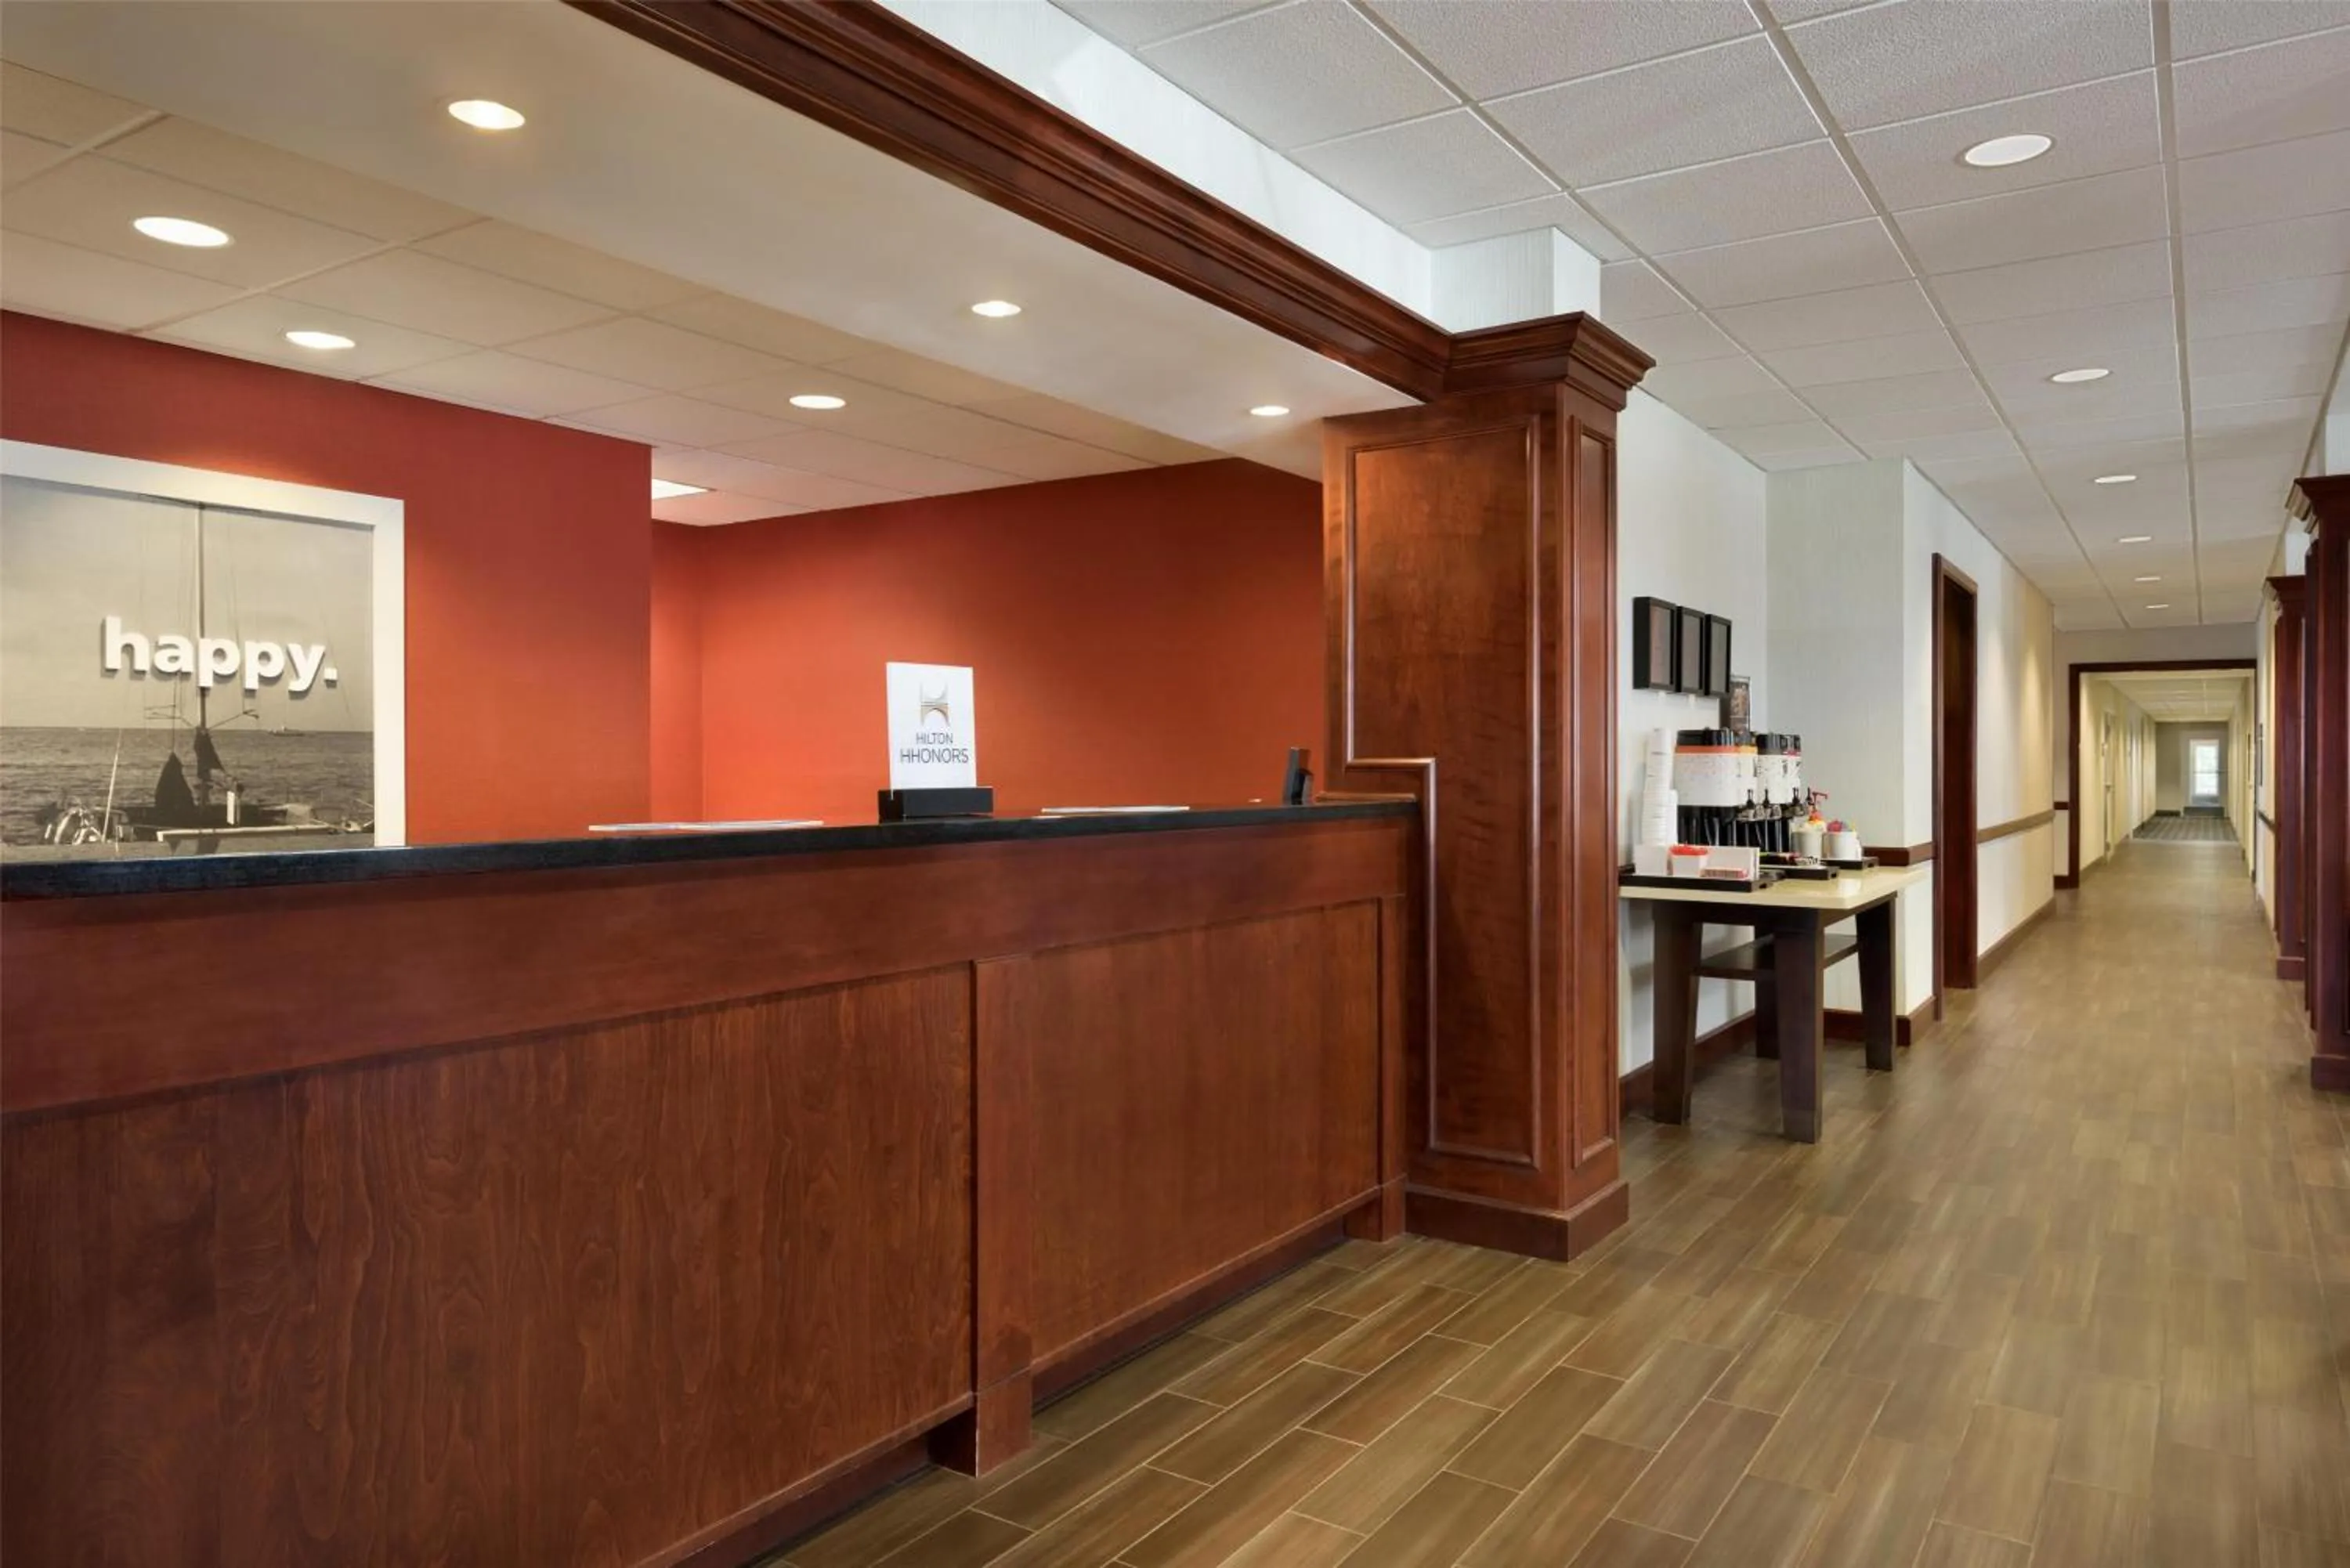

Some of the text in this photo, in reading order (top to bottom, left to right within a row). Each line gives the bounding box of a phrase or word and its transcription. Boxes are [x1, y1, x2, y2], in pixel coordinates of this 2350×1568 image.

[103, 615, 338, 693] happy.
[916, 732, 954, 745] HILTON
[900, 748, 970, 764] HHONORS
